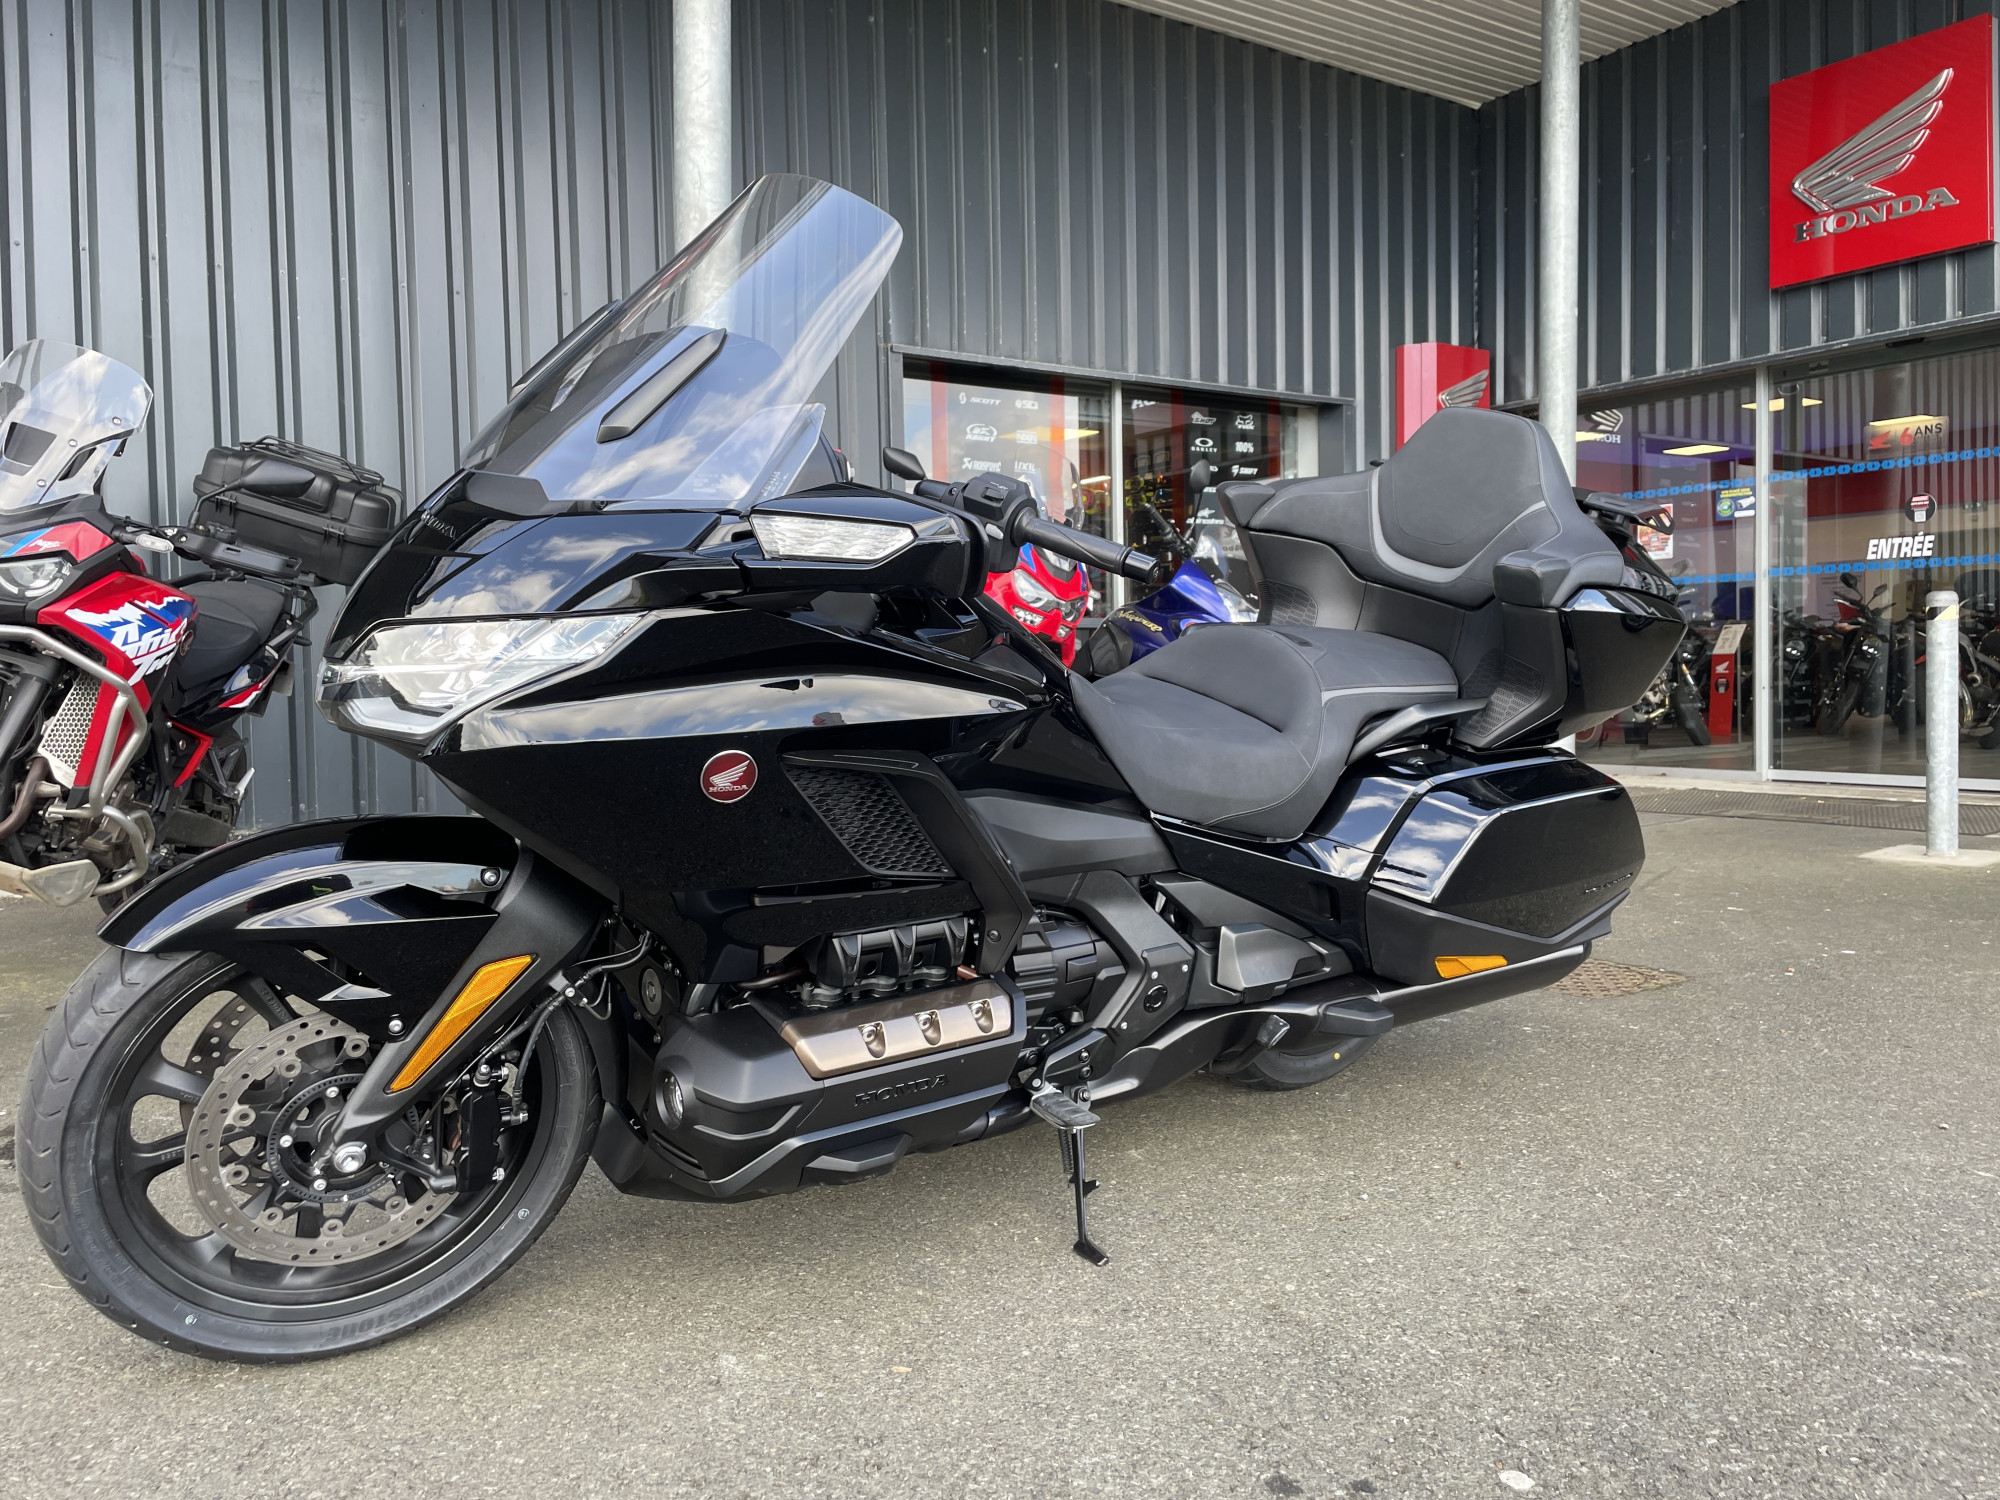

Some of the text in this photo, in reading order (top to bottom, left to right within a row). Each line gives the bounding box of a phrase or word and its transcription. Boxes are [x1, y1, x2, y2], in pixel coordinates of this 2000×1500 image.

[1793, 186, 1960, 244] HONDA
[1899, 423, 1942, 446] 6 ANS
[1866, 531, 1935, 560] ENTRÉE
[709, 784, 749, 793] HONDA
[854, 1074, 947, 1107] HONDA
